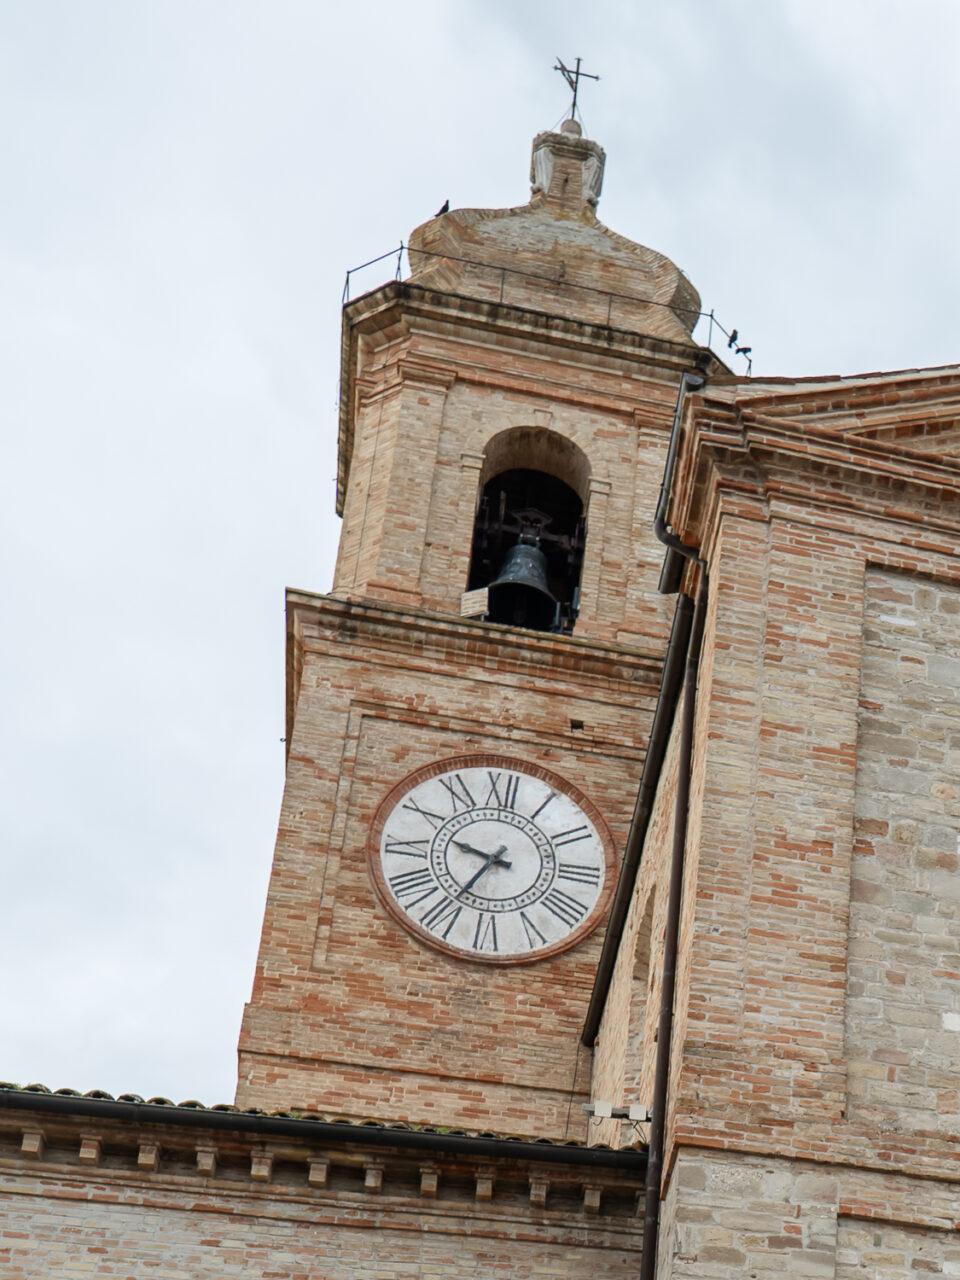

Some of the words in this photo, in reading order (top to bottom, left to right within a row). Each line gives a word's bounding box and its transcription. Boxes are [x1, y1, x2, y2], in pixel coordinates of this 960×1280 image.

[438, 773, 477, 814] XI
[486, 771, 520, 810] XII
[530, 792, 557, 820] I
[402, 797, 446, 830] X
[384, 834, 430, 860] IX
[549, 824, 593, 848] II
[388, 867, 439, 912] VIII
[557, 862, 600, 887] III
[419, 895, 463, 940] VII
[540, 887, 589, 929] IIII
[472, 912, 498, 952] VI
[519, 910, 548, 949] V
